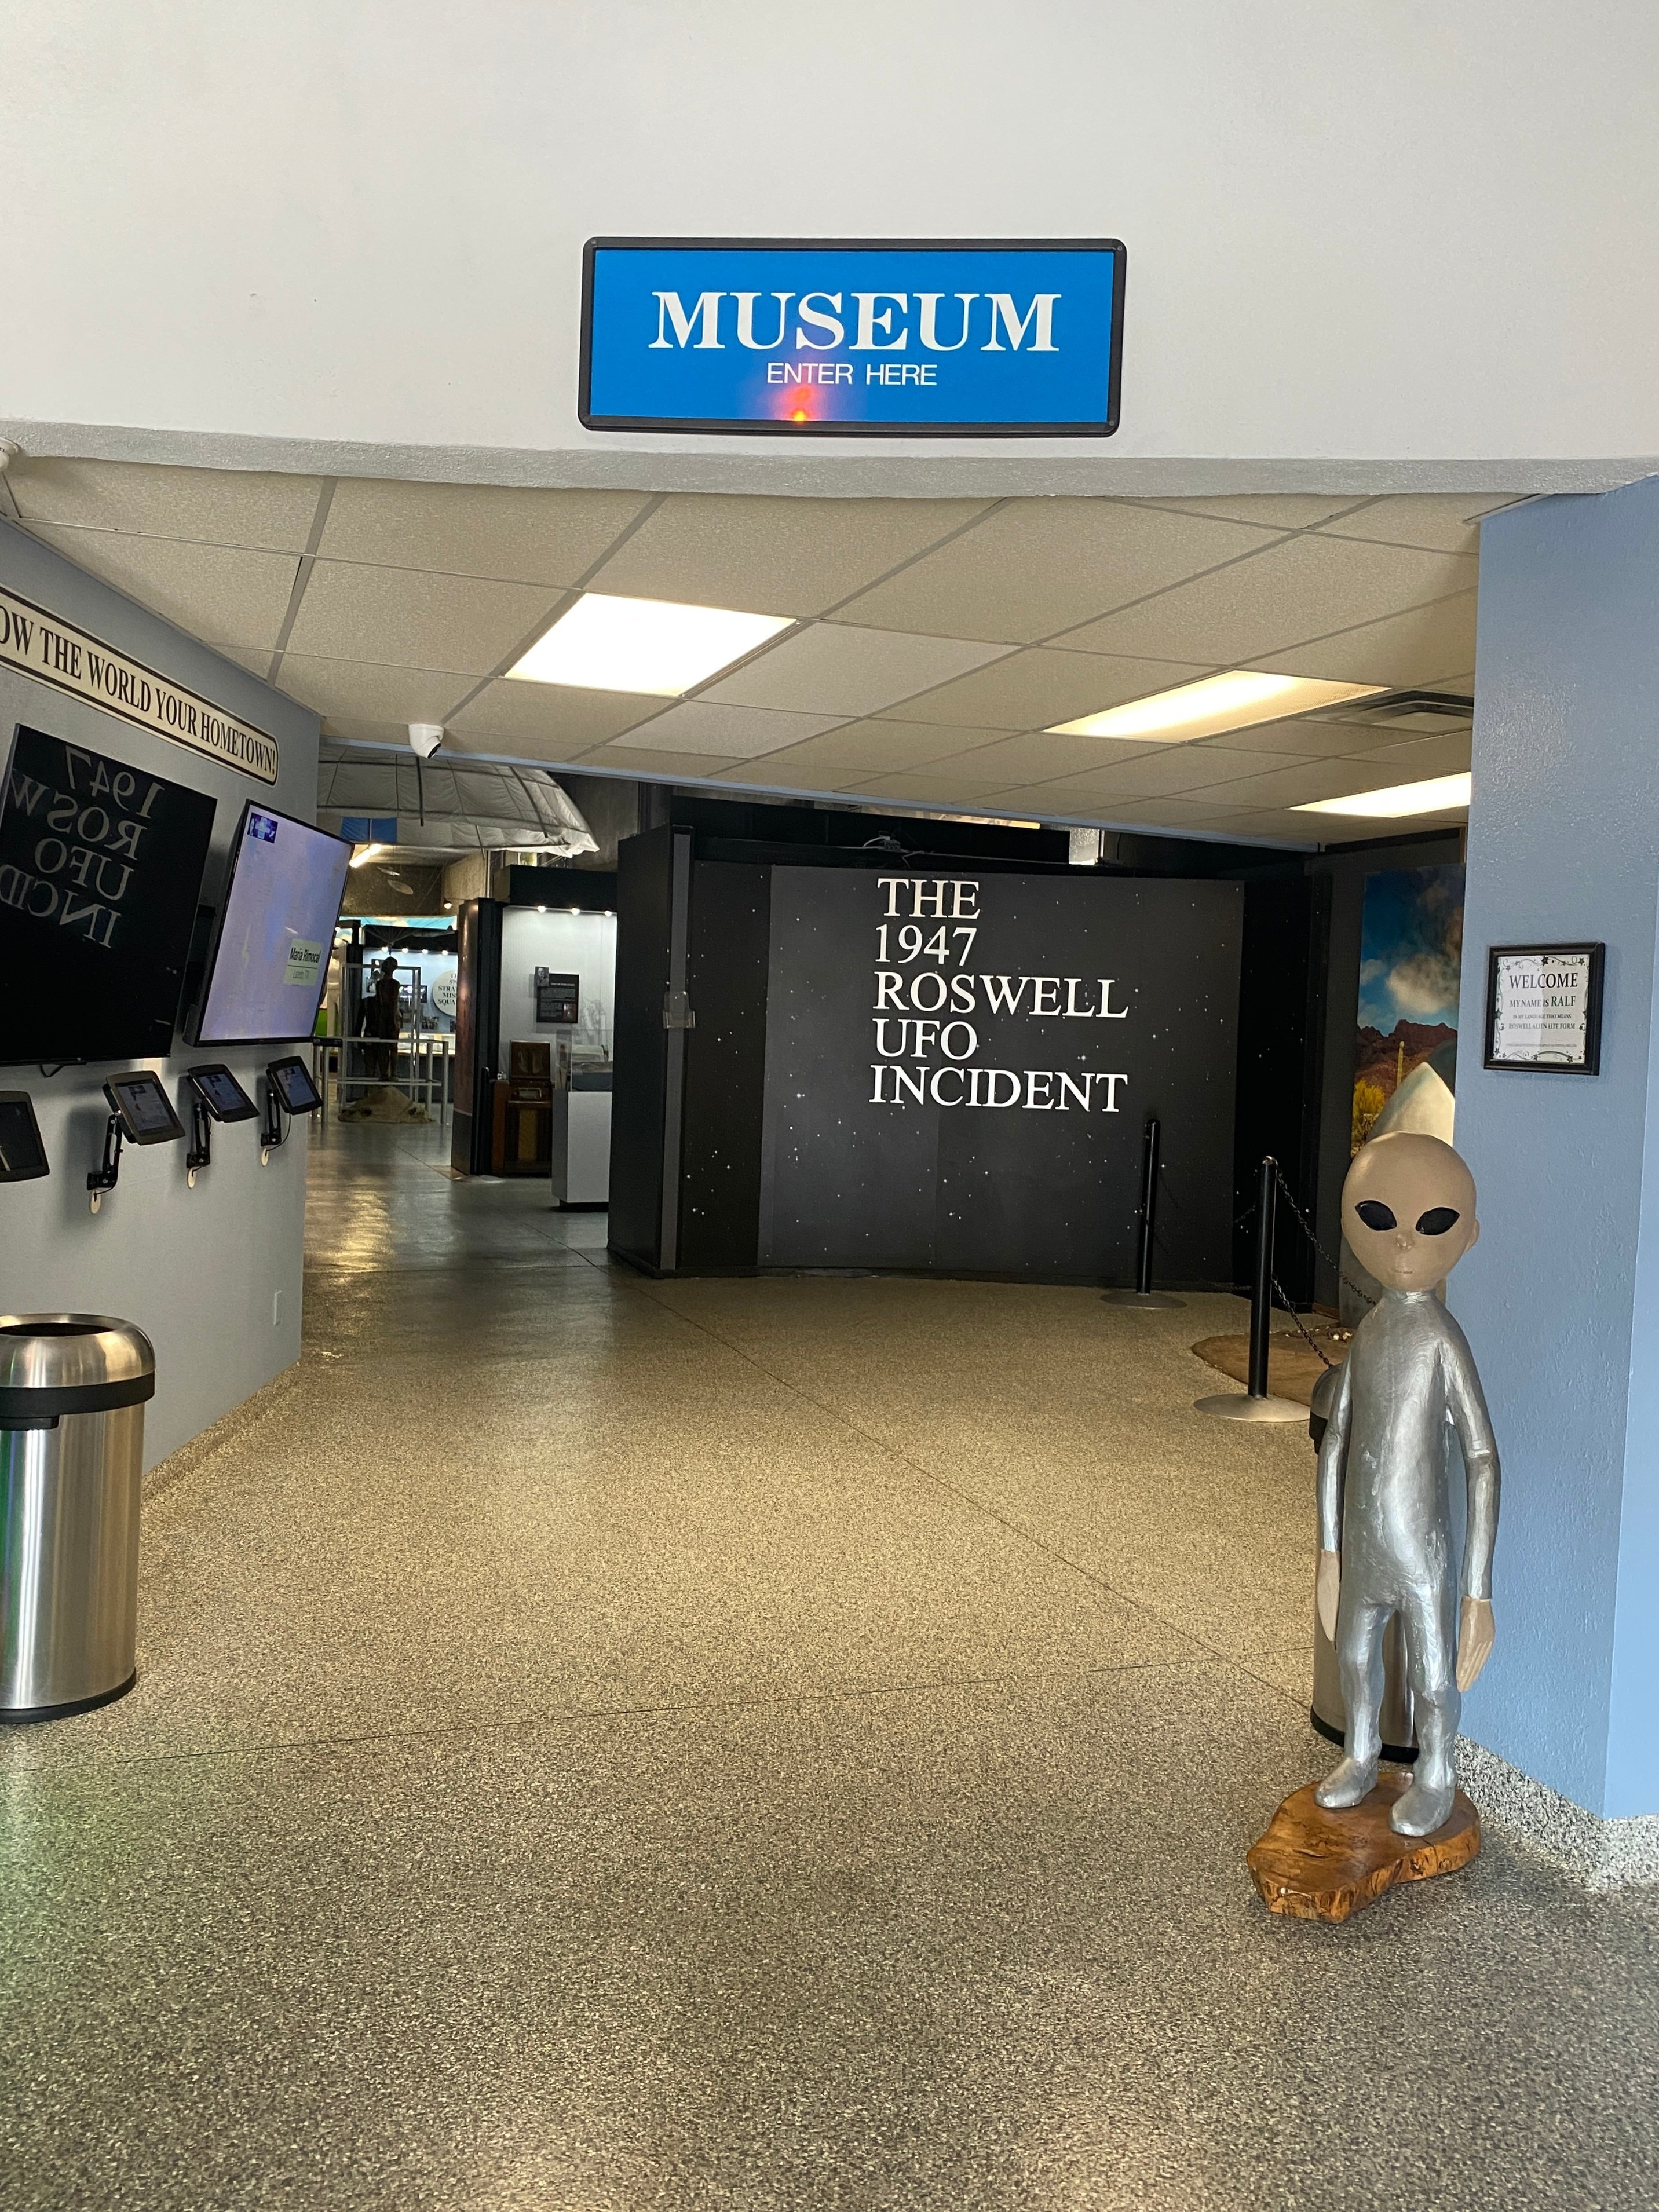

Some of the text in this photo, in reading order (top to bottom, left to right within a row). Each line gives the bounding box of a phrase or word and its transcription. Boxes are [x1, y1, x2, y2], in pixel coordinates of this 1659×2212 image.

[648, 291, 1061, 352] MUSEUM
[767, 363, 938, 386] ENTER HERE
[39, 627, 82, 679] THE
[87, 650, 151, 712] WORLD
[155, 688, 197, 737] YOUR
[200, 711, 275, 775] HOMETOWN!
[877, 878, 980, 919] THE
[875, 924, 977, 966] 1947
[873, 971, 1129, 1018] ROSWELL
[1509, 973, 1578, 989] WELCOME
[1551, 996, 1576, 1007] RALF
[872, 1018, 978, 1061] UFO
[869, 1065, 1128, 1112] INCIDENT
